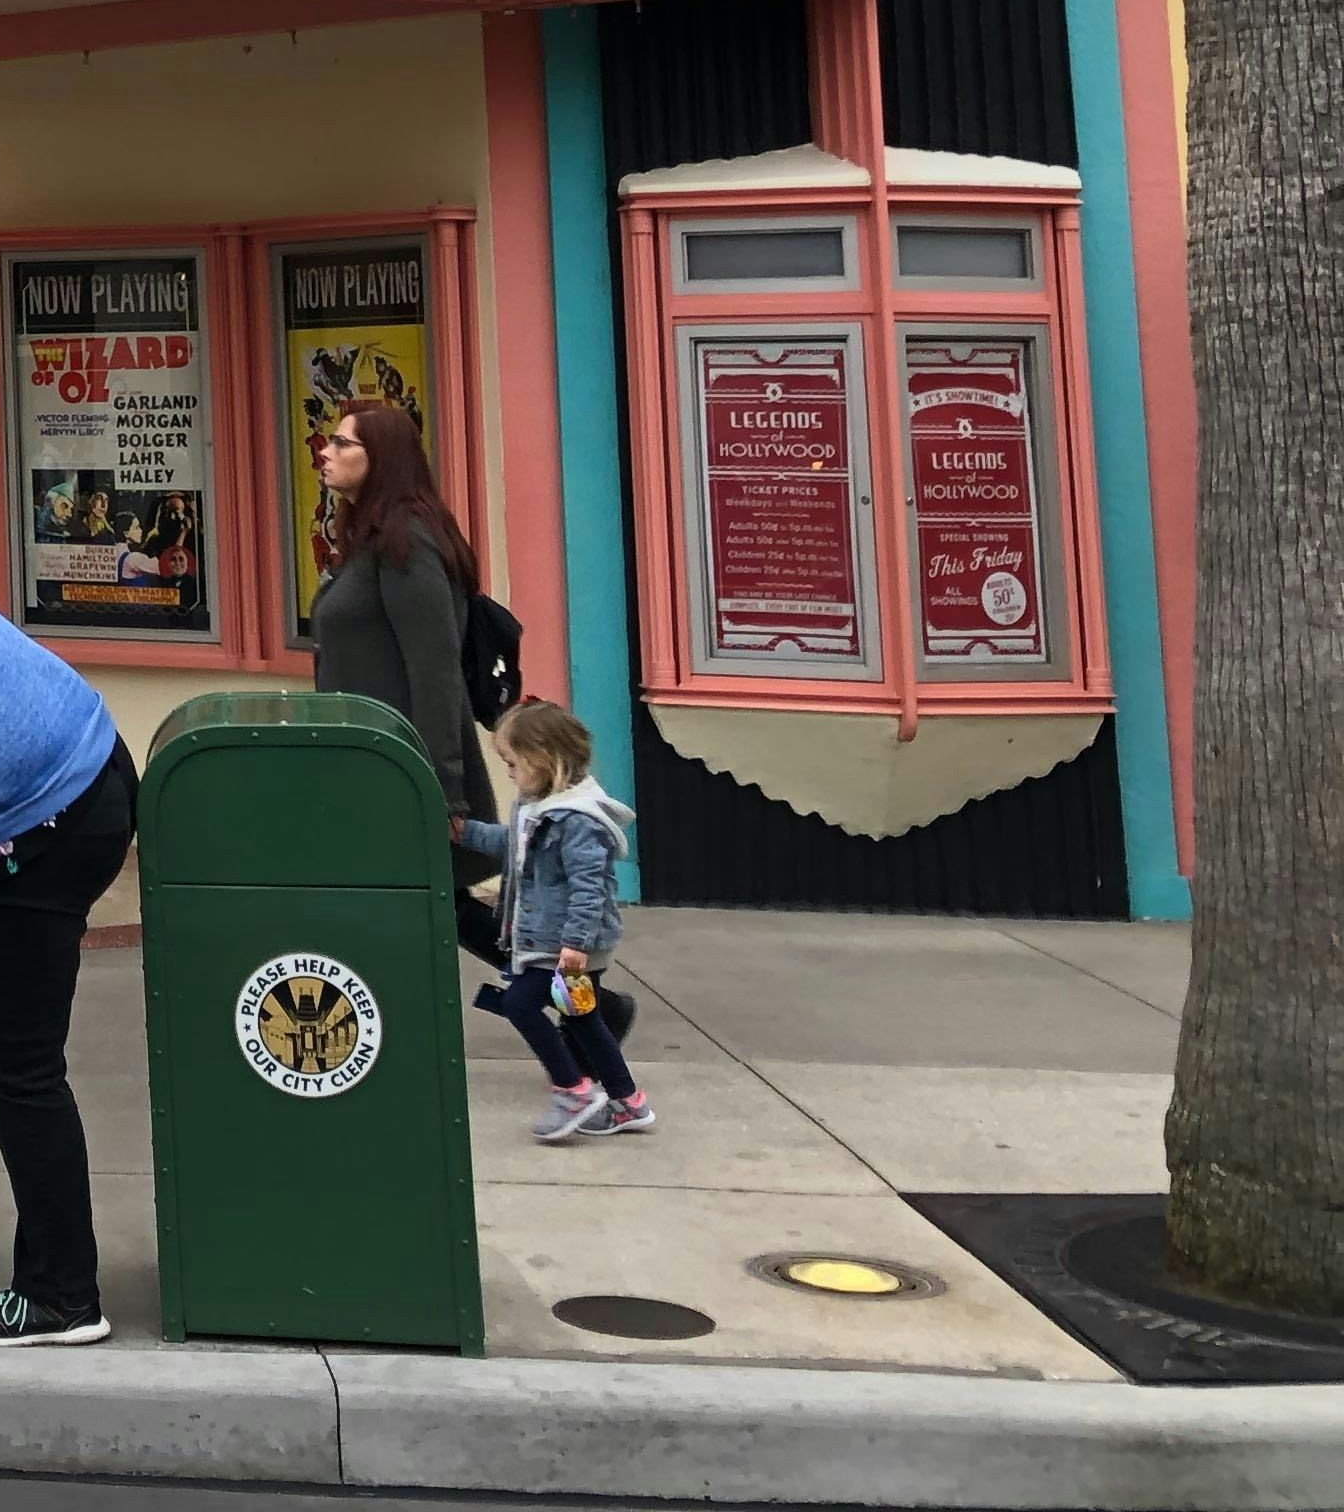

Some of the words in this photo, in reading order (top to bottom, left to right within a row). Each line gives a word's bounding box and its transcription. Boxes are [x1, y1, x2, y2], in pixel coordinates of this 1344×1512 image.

[296, 266, 337, 309] NOW
[344, 260, 419, 307] PLAYING
[29, 275, 81, 315] NOW
[91, 272, 188, 313] PLAYING
[30, 336, 193, 370] WIZARD
[35, 348, 65, 361] THE
[31, 371, 55, 386] OF
[58, 371, 110, 404] OZ
[113, 395, 198, 410] GARLAND
[71, 414, 109, 423] FLEMING
[116, 413, 192, 429] MORGAN
[730, 411, 823, 428] LEGENDS
[117, 433, 188, 448] BOLGER
[770, 430, 784, 442] of
[719, 443, 835, 458] HOLLYWOOD
[119, 451, 166, 466] LAHR
[931, 452, 1007, 470] LEGENDS
[120, 469, 174, 484] HALEY
[965, 472, 977, 483] of
[742, 486, 779, 495] TICKET
[781, 486, 819, 496] PRICES
[923, 484, 1019, 500] HOLLYWOOD
[928, 553, 965, 578] This
[969, 545, 1023, 572] Friday
[945, 587, 962, 596] ALL
[241, 962, 288, 1017] PLEASE
[294, 958, 341, 978] HELP
[342, 977, 375, 1020] KEEP
[245, 1038, 278, 1077] OUR
[282, 1074, 323, 1092] CITY
[330, 1042, 374, 1088] CLEAN
